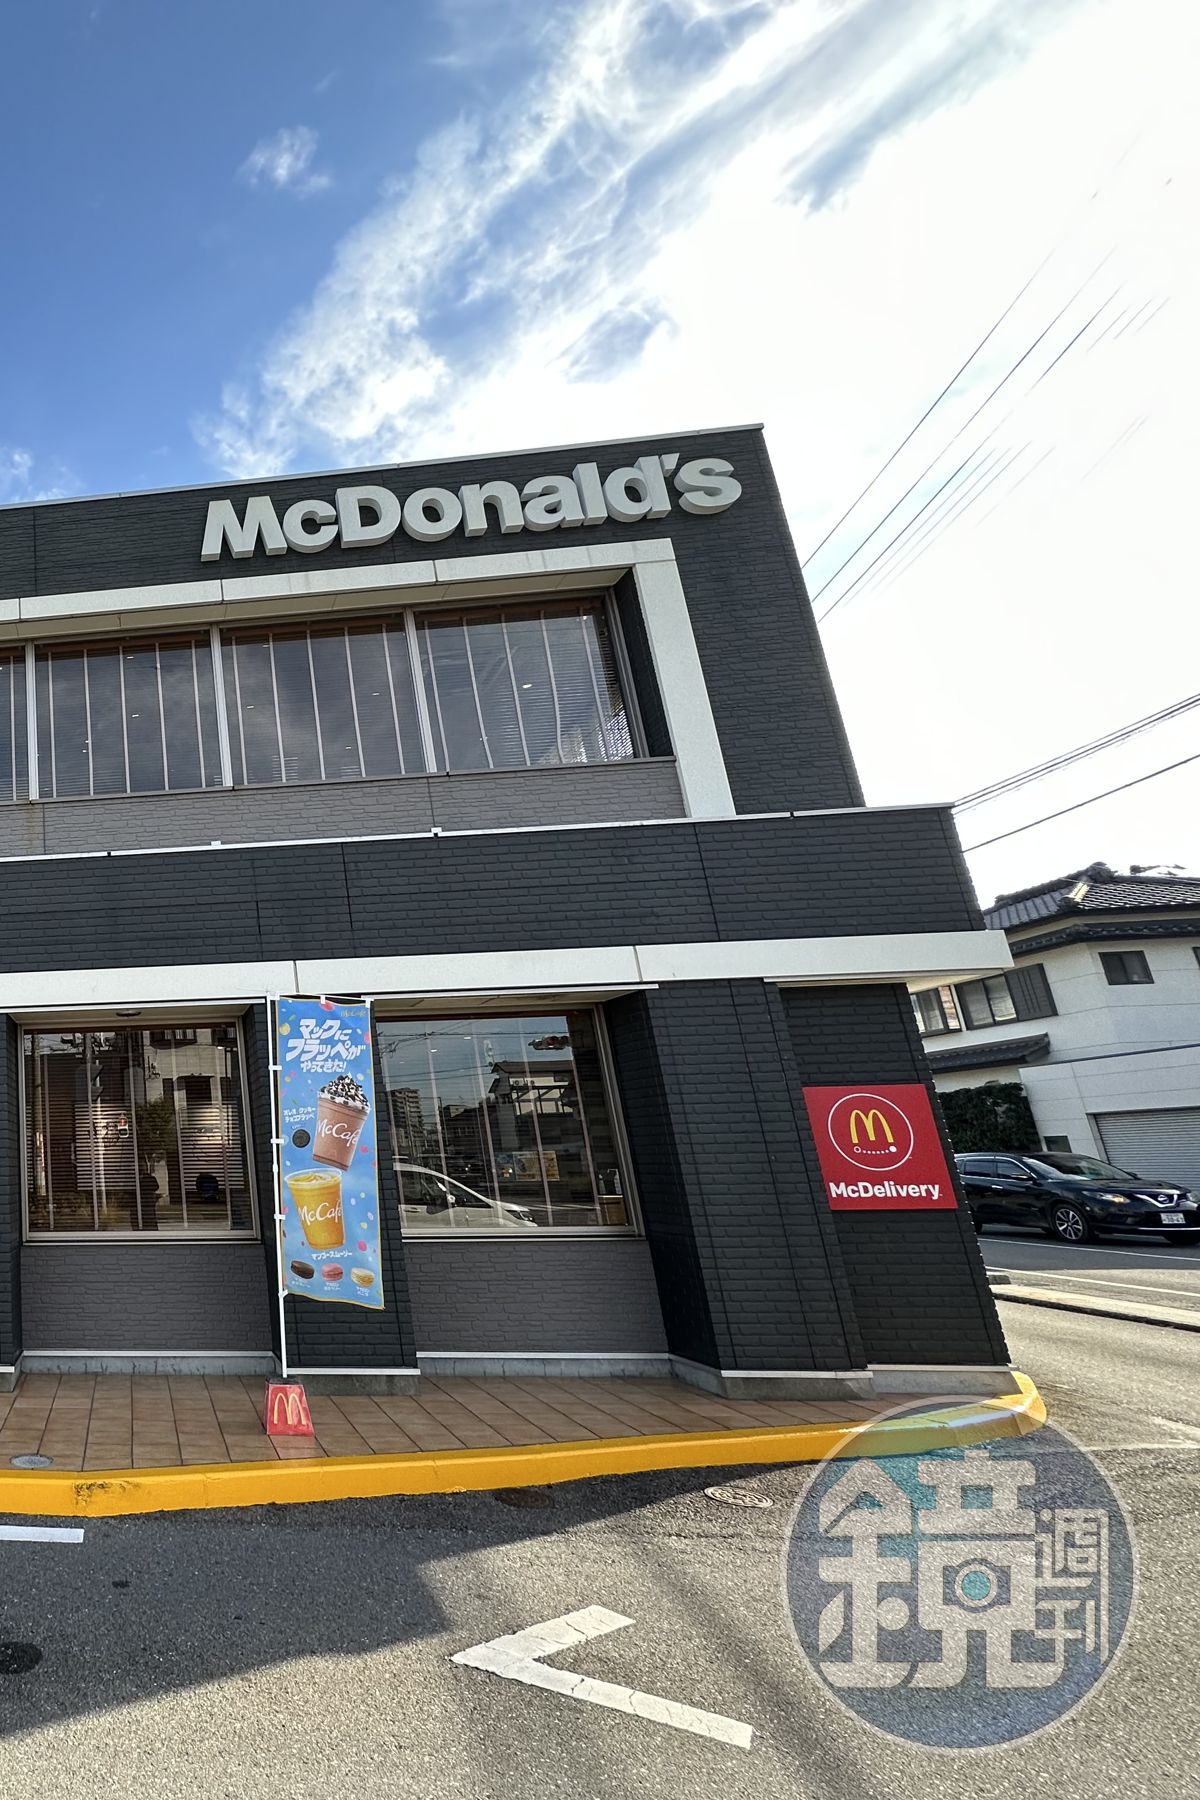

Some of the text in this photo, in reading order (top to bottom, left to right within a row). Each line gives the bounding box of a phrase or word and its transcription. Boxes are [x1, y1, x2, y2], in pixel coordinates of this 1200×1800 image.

[201, 452, 743, 562] McDonald's
[299, 1018, 353, 1041] マックに
[285, 1038, 366, 1062] フラッペが
[828, 1180, 940, 1200] McDelivery
